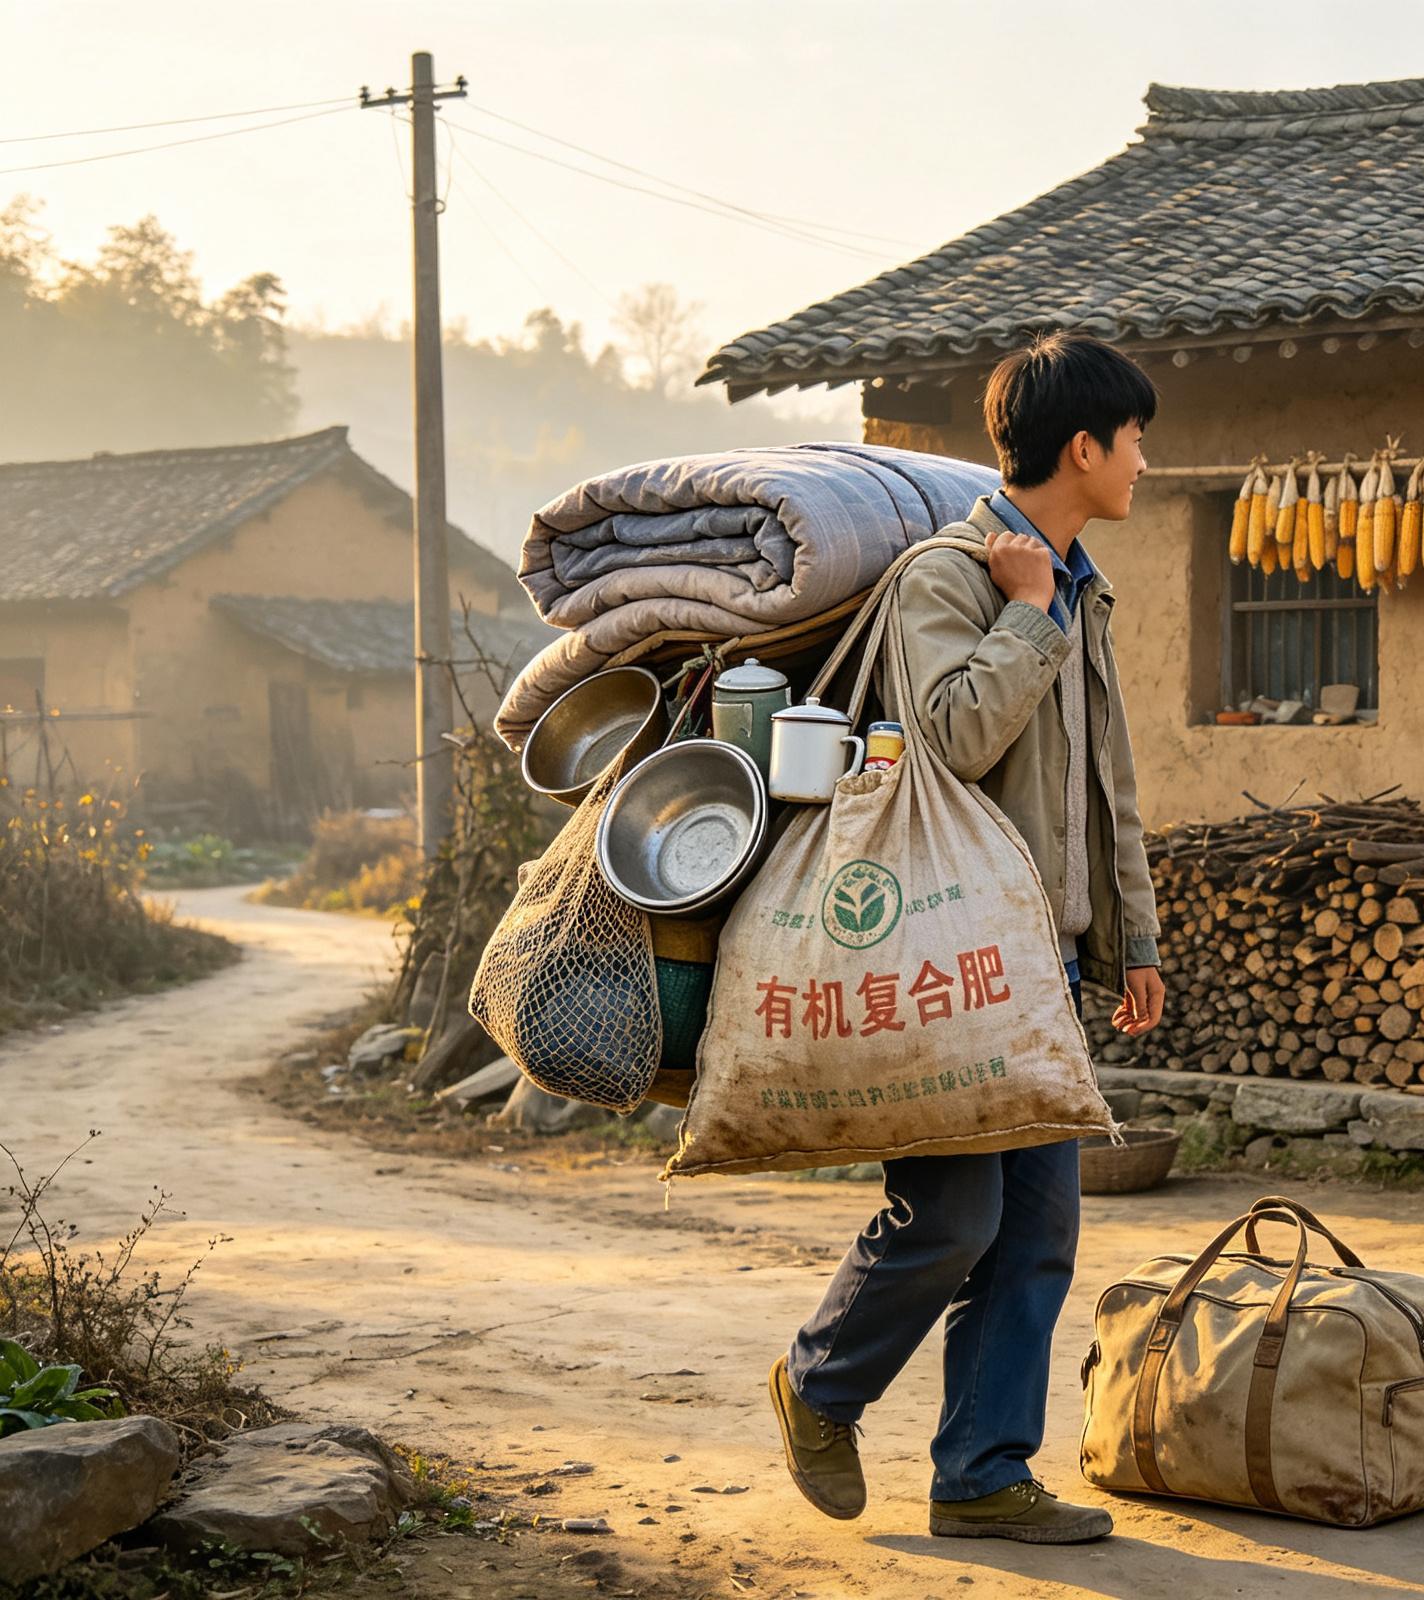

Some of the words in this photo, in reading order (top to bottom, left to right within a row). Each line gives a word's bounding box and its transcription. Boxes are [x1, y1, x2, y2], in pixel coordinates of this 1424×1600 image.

[755, 945, 1011, 1040] 有机复合肥
